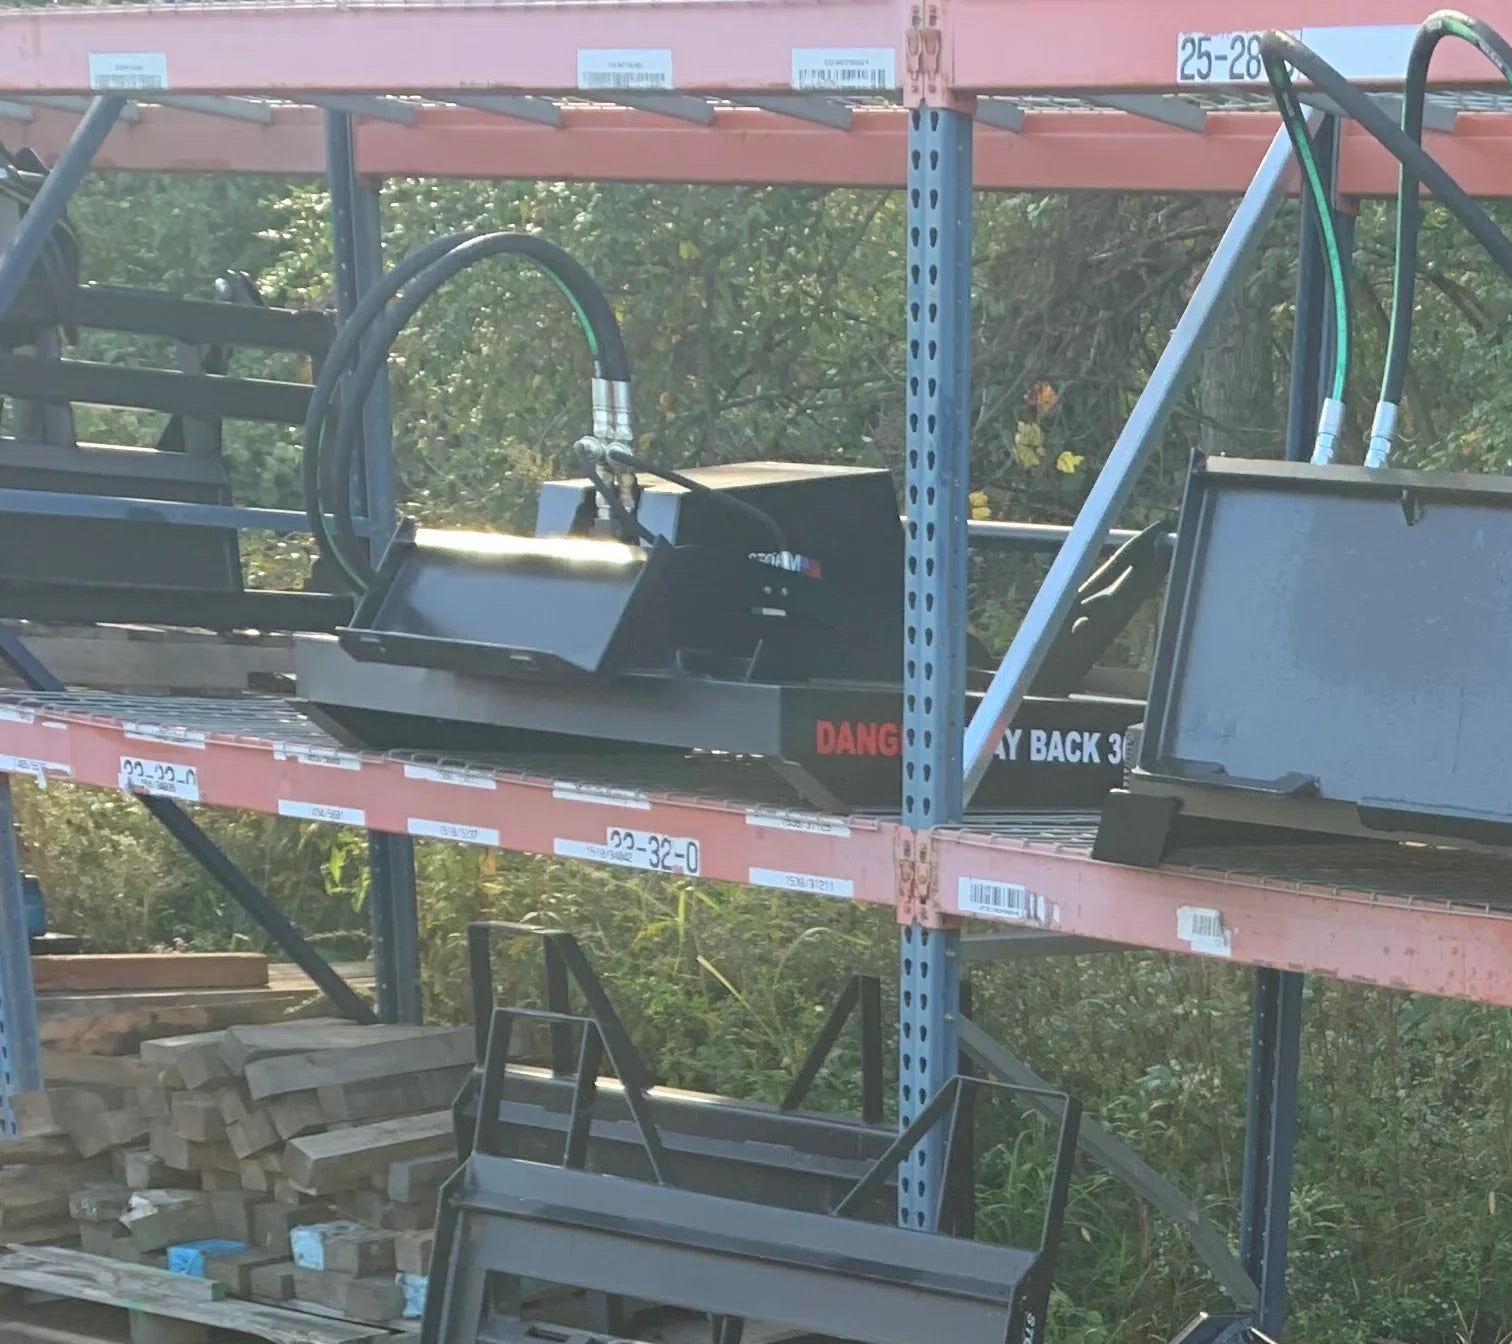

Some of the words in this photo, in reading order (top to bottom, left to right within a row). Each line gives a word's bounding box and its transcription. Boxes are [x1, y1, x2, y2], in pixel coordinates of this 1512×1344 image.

[1180, 34, 1294, 80] 25-28
[816, 719, 903, 757] DANG
[1030, 729, 1101, 764] BACK
